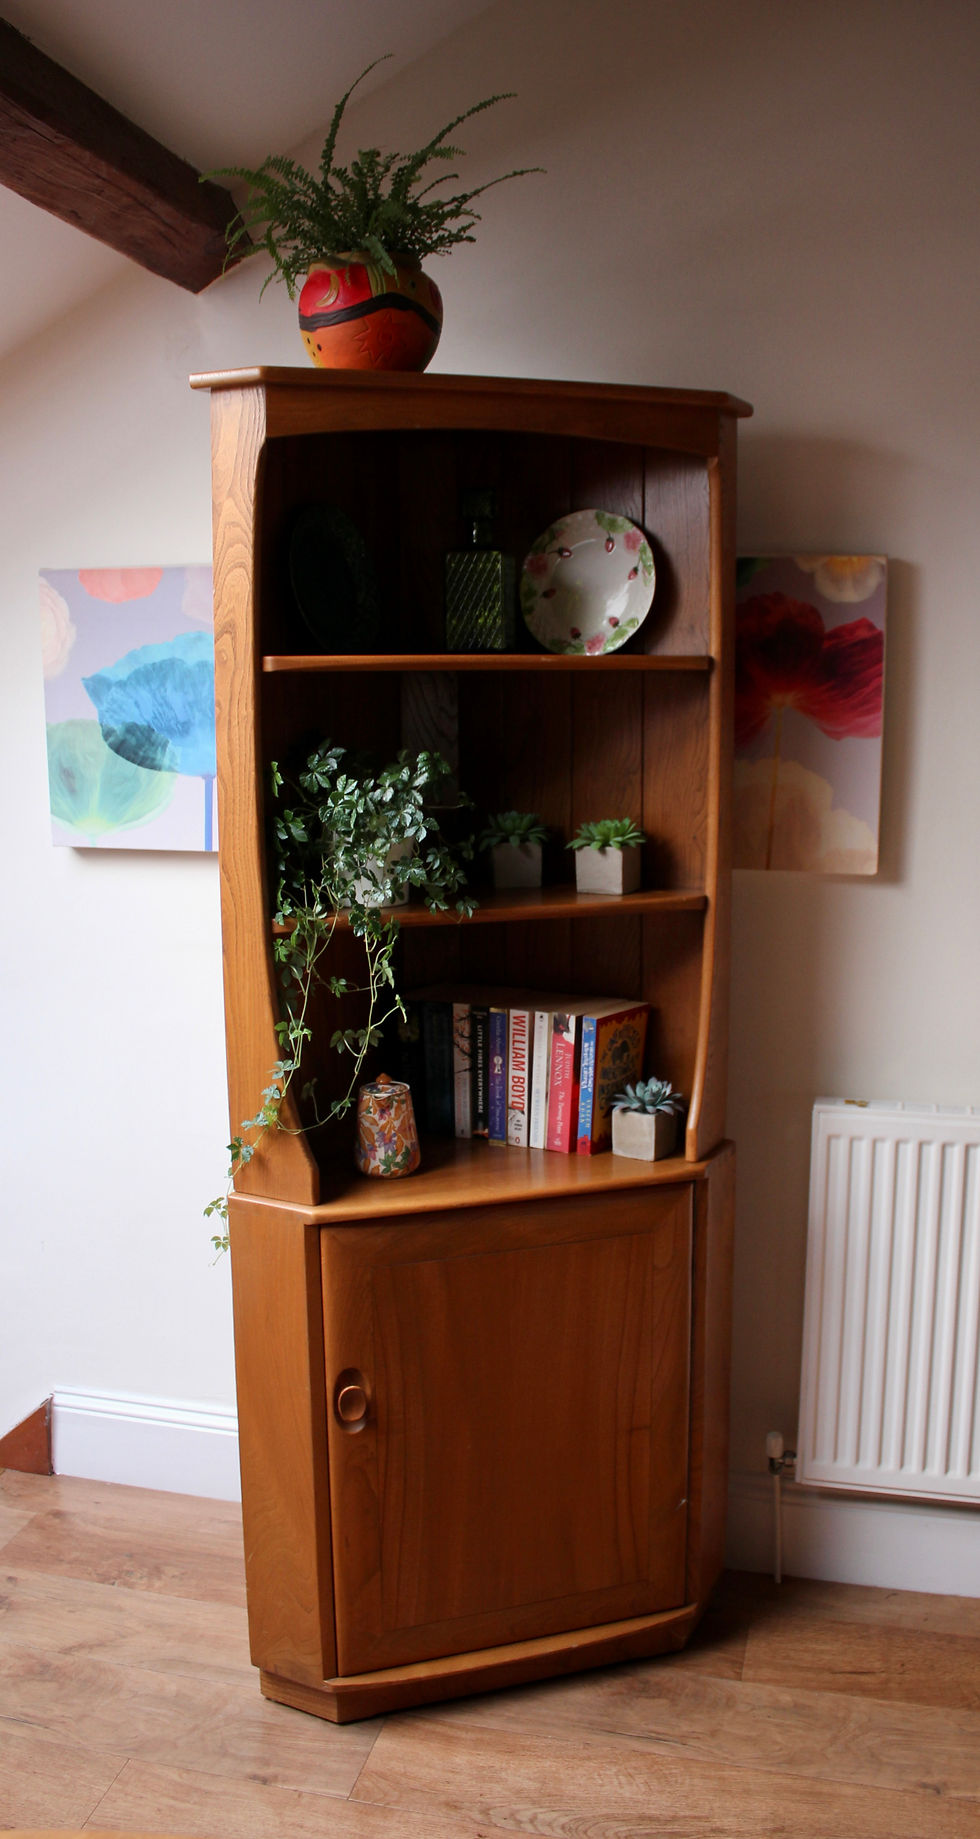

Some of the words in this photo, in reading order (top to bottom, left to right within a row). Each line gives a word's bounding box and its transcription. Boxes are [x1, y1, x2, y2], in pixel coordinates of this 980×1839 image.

[512, 1015, 526, 1072] WILLIAM
[554, 1042, 566, 1086] LENNOX
[564, 1053, 572, 1079] JUDITH
[511, 1075, 525, 1111] BOYD
